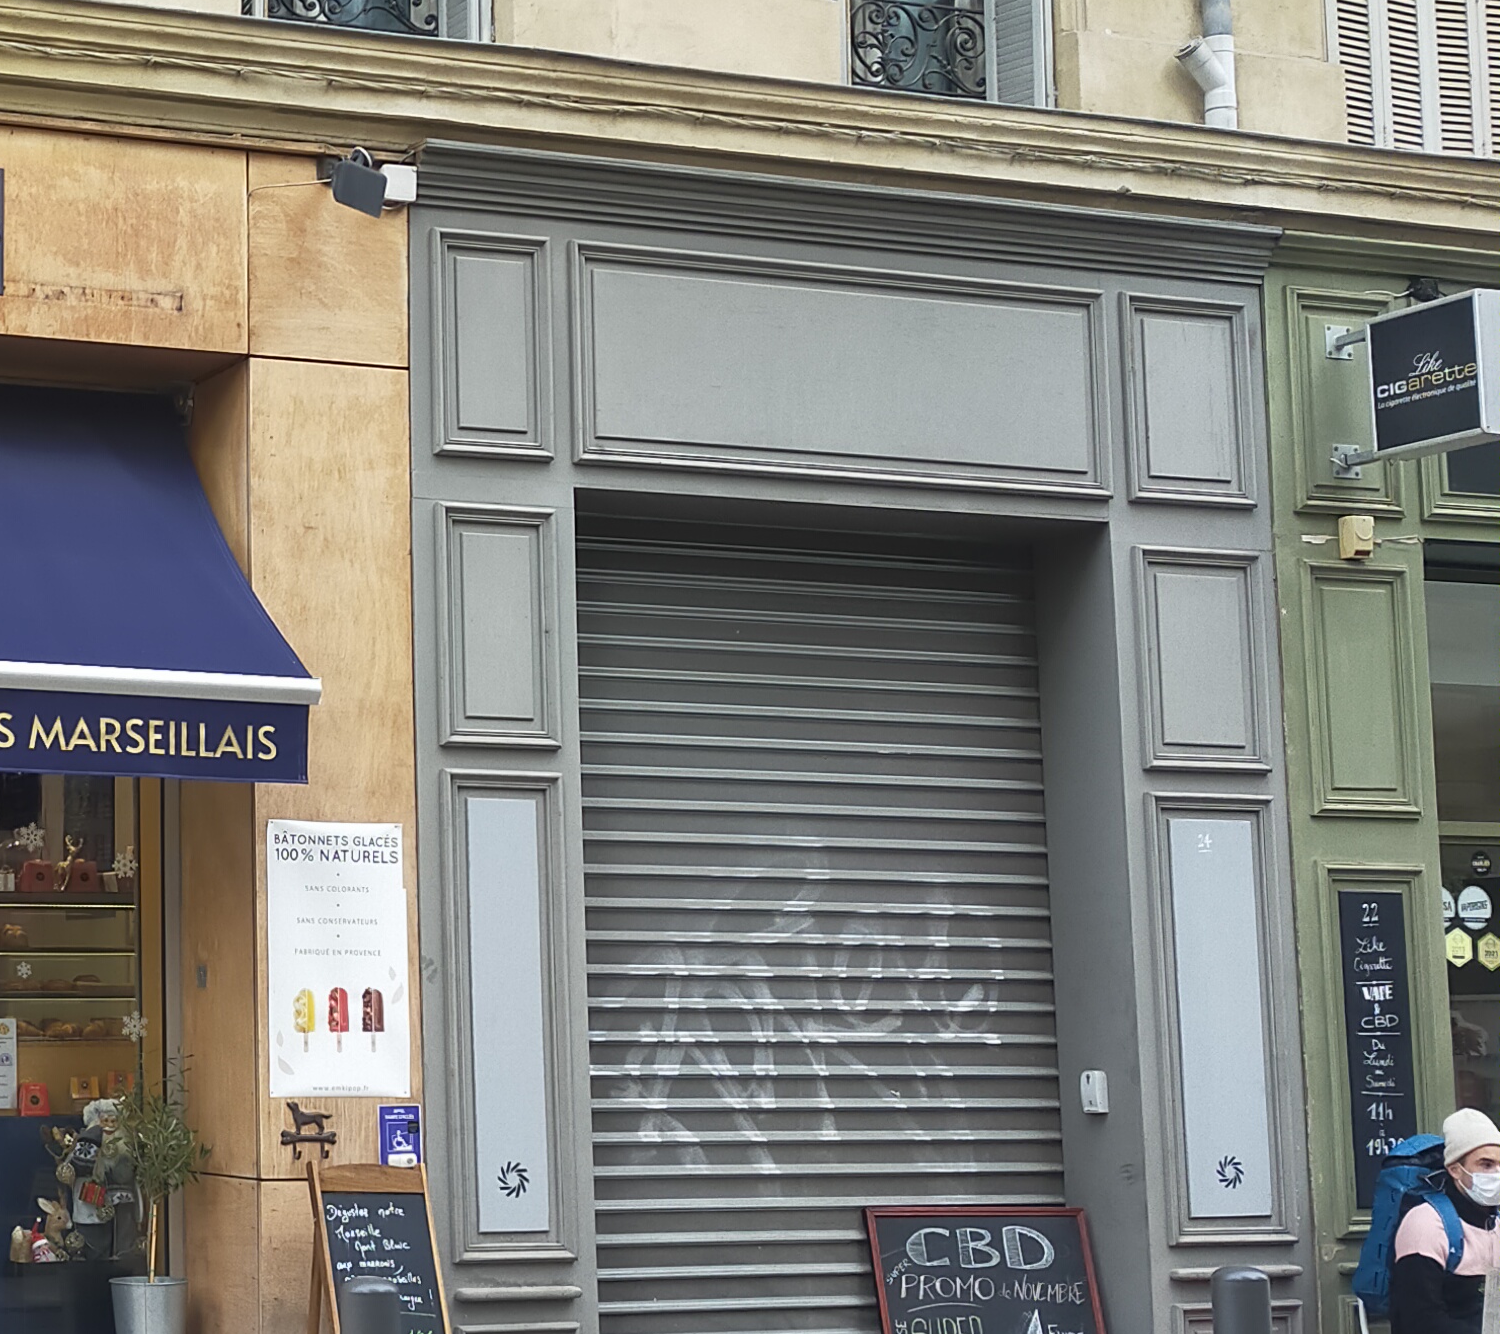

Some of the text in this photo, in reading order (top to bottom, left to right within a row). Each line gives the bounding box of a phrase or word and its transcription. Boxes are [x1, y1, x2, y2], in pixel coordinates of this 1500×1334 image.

[1408, 351, 1443, 377] Like
[1385, 396, 1411, 408] cigarette
[1411, 387, 1447, 402] électronique
[28, 714, 278, 761] MARSEILLAIS
[274, 830, 399, 848] BÂTONNETS GLACÉS
[1197, 833, 1213, 848] 24
[320, 849, 399, 864] NATURELS
[326, 885, 370, 893] COLORANTS
[1362, 902, 1379, 922] 22
[318, 917, 378, 926] CONSERVATEURS
[294, 948, 382, 957] FABRIQUÉ EN PROVENCE
[1355, 935, 1387, 954] Like
[1361, 985, 1393, 1001] VAPE
[1361, 1014, 1399, 1028] CBD
[1371, 1039, 1386, 1051] Du
[1363, 1051, 1394, 1066] Lundi
[1365, 1074, 1396, 1088] Samedi
[1366, 1102, 1393, 1120] 11h
[377, 1201, 406, 1218] notre
[335, 1223, 382, 1243] Marseille
[905, 1225, 1055, 1270] CBD
[886, 1257, 914, 1286] SUPER
[900, 1273, 1087, 1305] PROMO de NOVEMBRE
